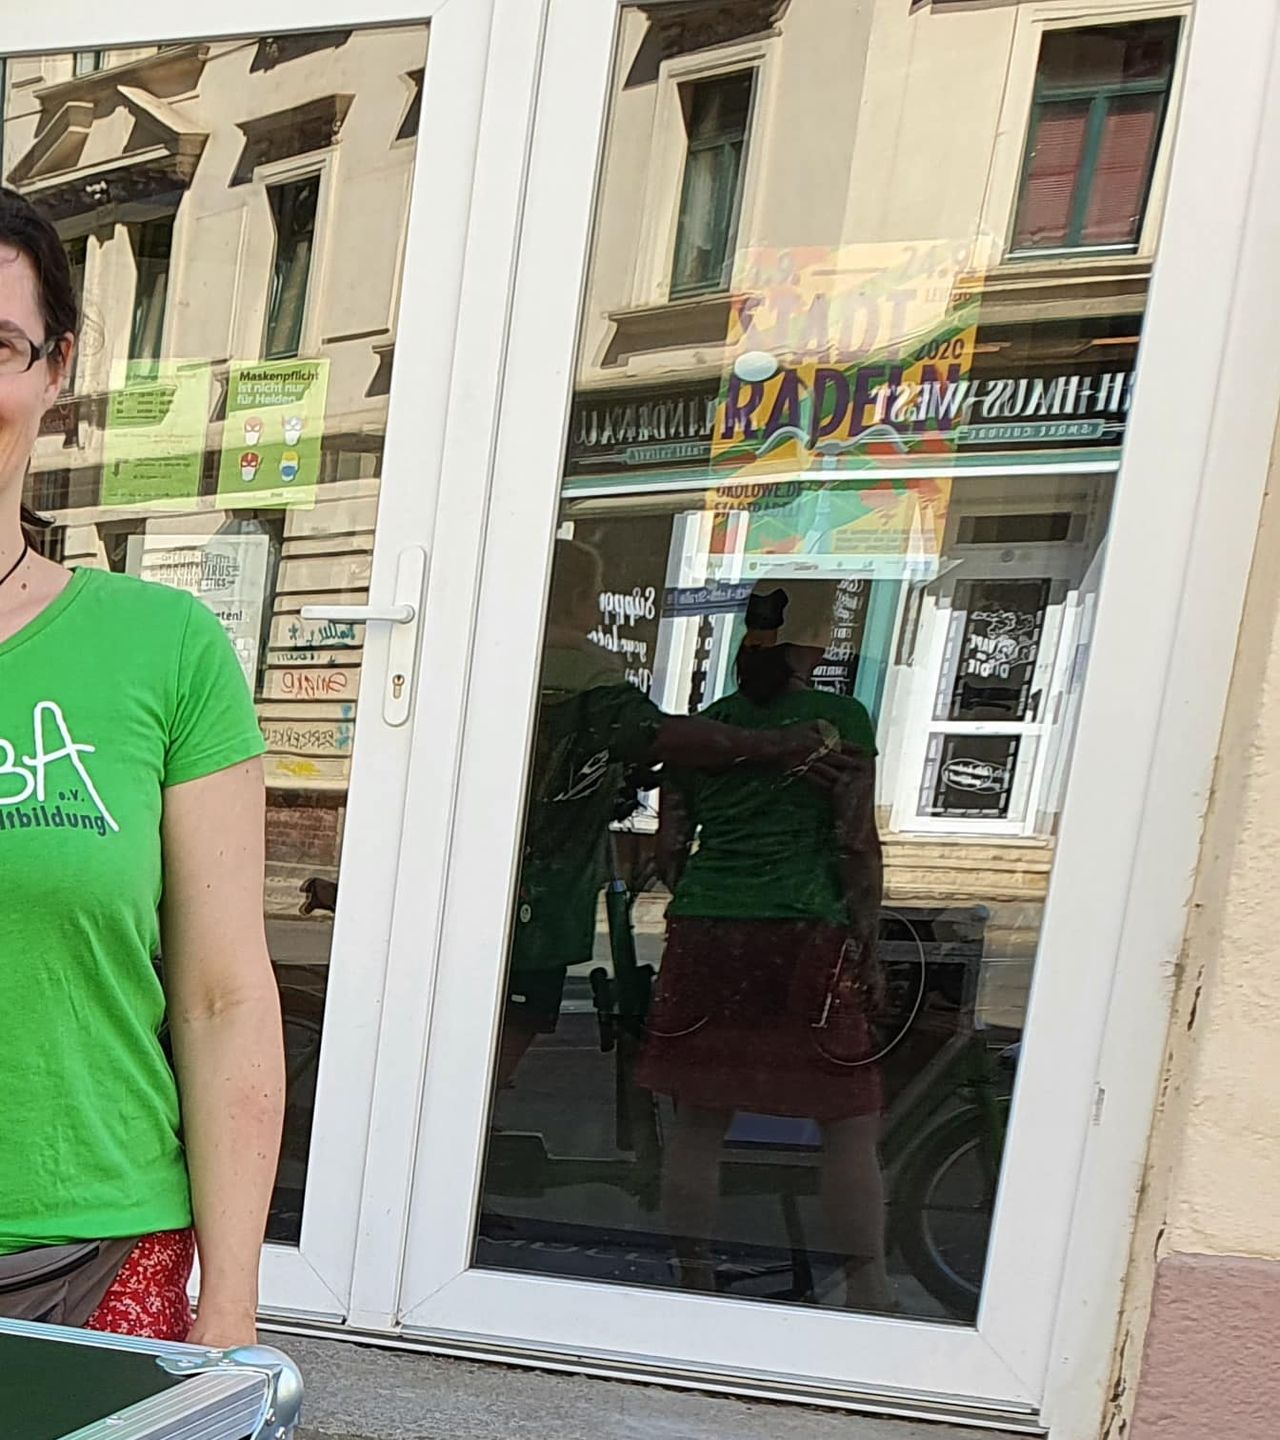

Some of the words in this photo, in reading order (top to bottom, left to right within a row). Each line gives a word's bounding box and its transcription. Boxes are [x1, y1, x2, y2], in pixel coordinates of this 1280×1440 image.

[918, 338, 965, 362] 2020
[240, 369, 320, 382] Maskenpflicht
[254, 382, 282, 393] nicht
[721, 363, 961, 441] RADELN
